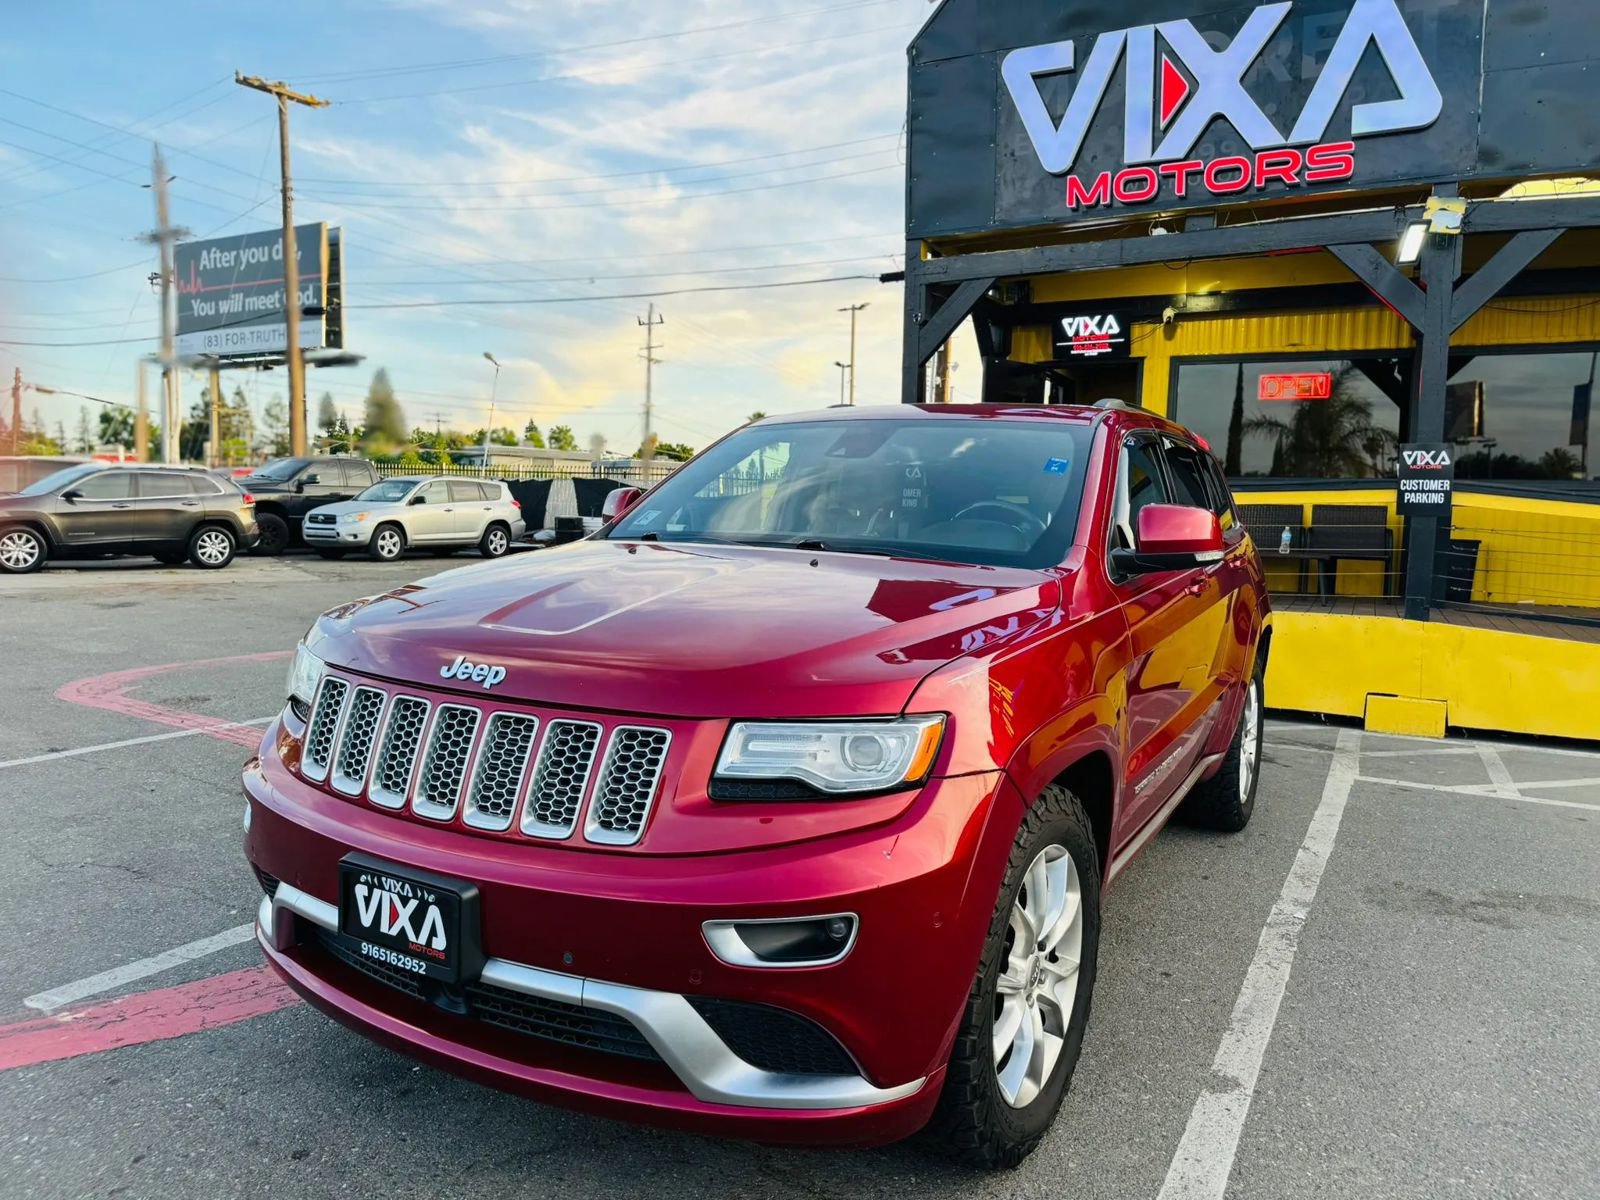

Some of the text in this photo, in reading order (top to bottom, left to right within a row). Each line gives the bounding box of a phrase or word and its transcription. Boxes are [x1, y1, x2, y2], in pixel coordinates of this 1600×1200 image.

[1001, 0, 1443, 175] VIXA
[1066, 141, 1355, 209] MOTORS
[200, 247, 235, 270] After
[240, 246, 269, 270] you
[192, 299, 215, 317] You
[217, 294, 243, 314] will
[245, 294, 280, 311] meet
[1062, 314, 1120, 337] VIXA
[203, 334, 223, 351] (83)
[225, 328, 286, 346] FOR-TRUTH
[1263, 376, 1326, 396] OPEN
[1402, 450, 1451, 465] VIXA
[1400, 480, 1450, 491] CUSTOMER
[1404, 493, 1445, 504] PARKING
[440, 656, 506, 689] Jeep
[382, 877, 413, 897] VIXA
[355, 884, 446, 951] VIXA
[361, 942, 426, 974] 9165162952
[409, 943, 446, 960] MOTORS
